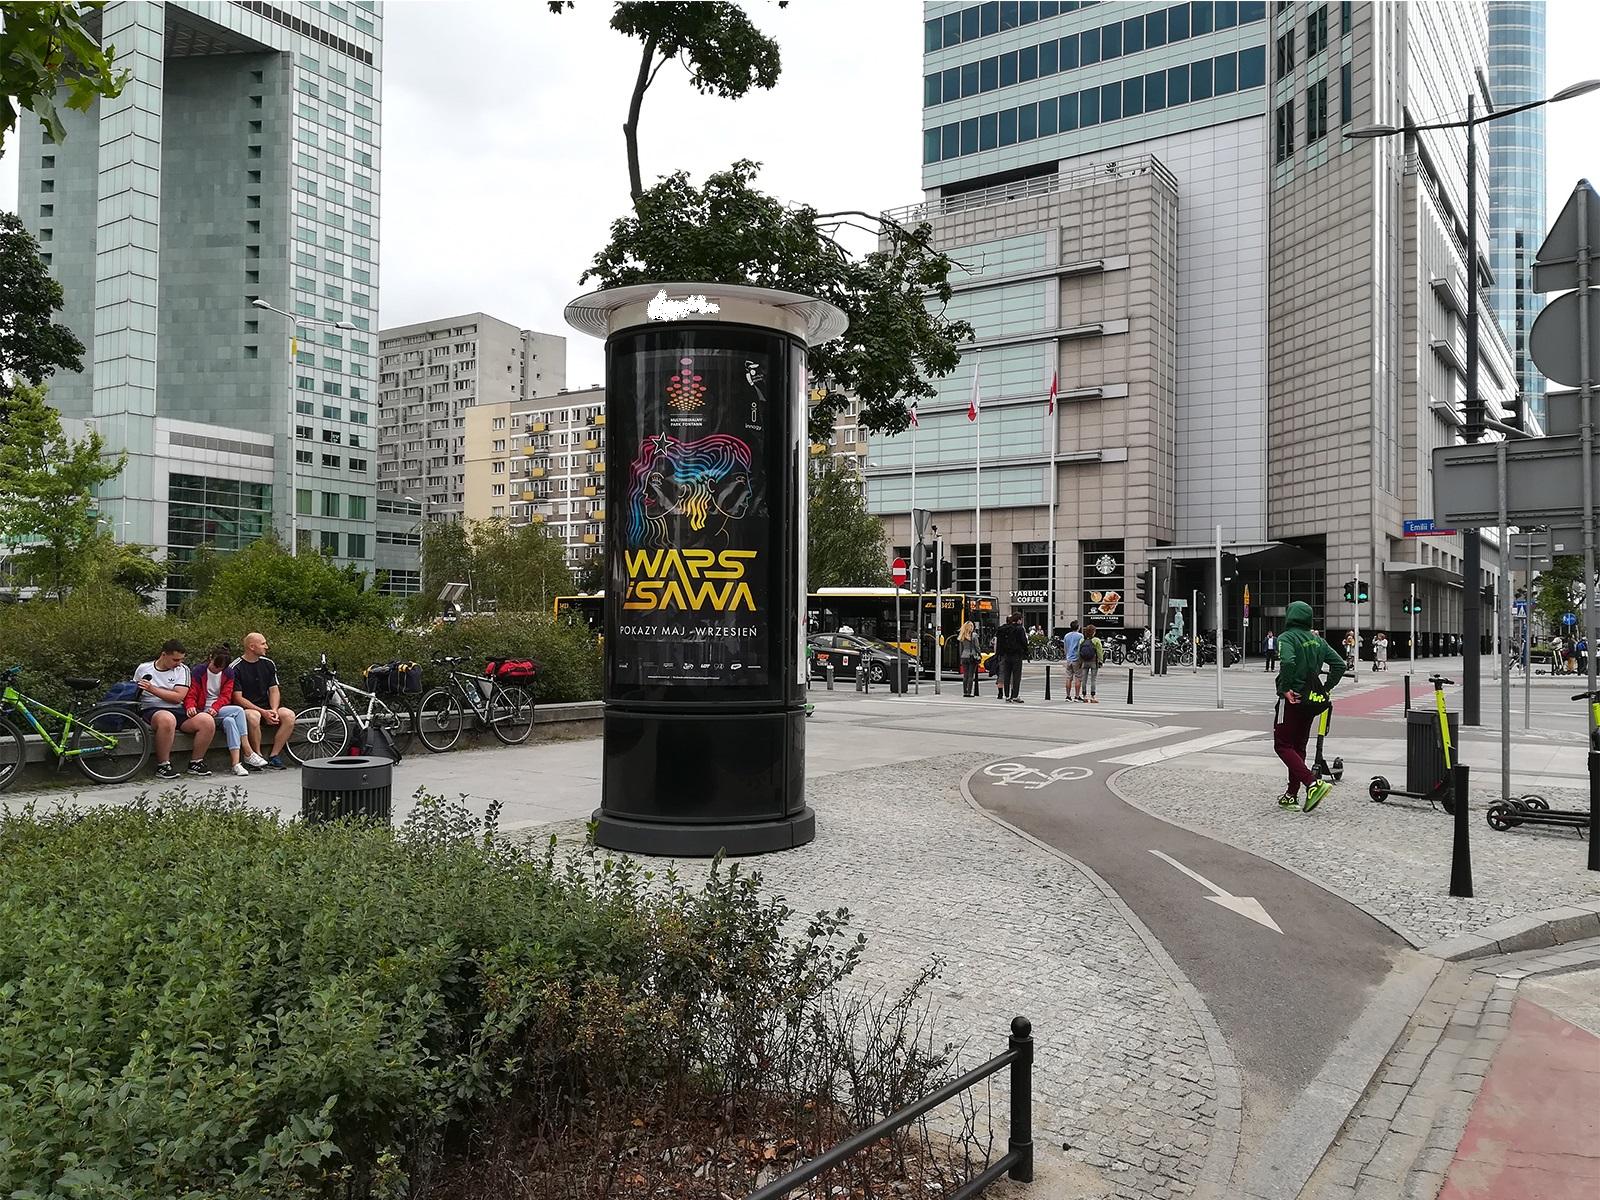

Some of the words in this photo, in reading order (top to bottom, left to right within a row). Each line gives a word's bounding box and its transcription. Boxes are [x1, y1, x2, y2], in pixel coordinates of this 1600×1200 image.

[624, 549, 757, 579] WARS
[620, 626, 658, 635] POKAZY
[662, 626, 685, 636] MAJ
[695, 626, 757, 637] WRZESIEŃ
